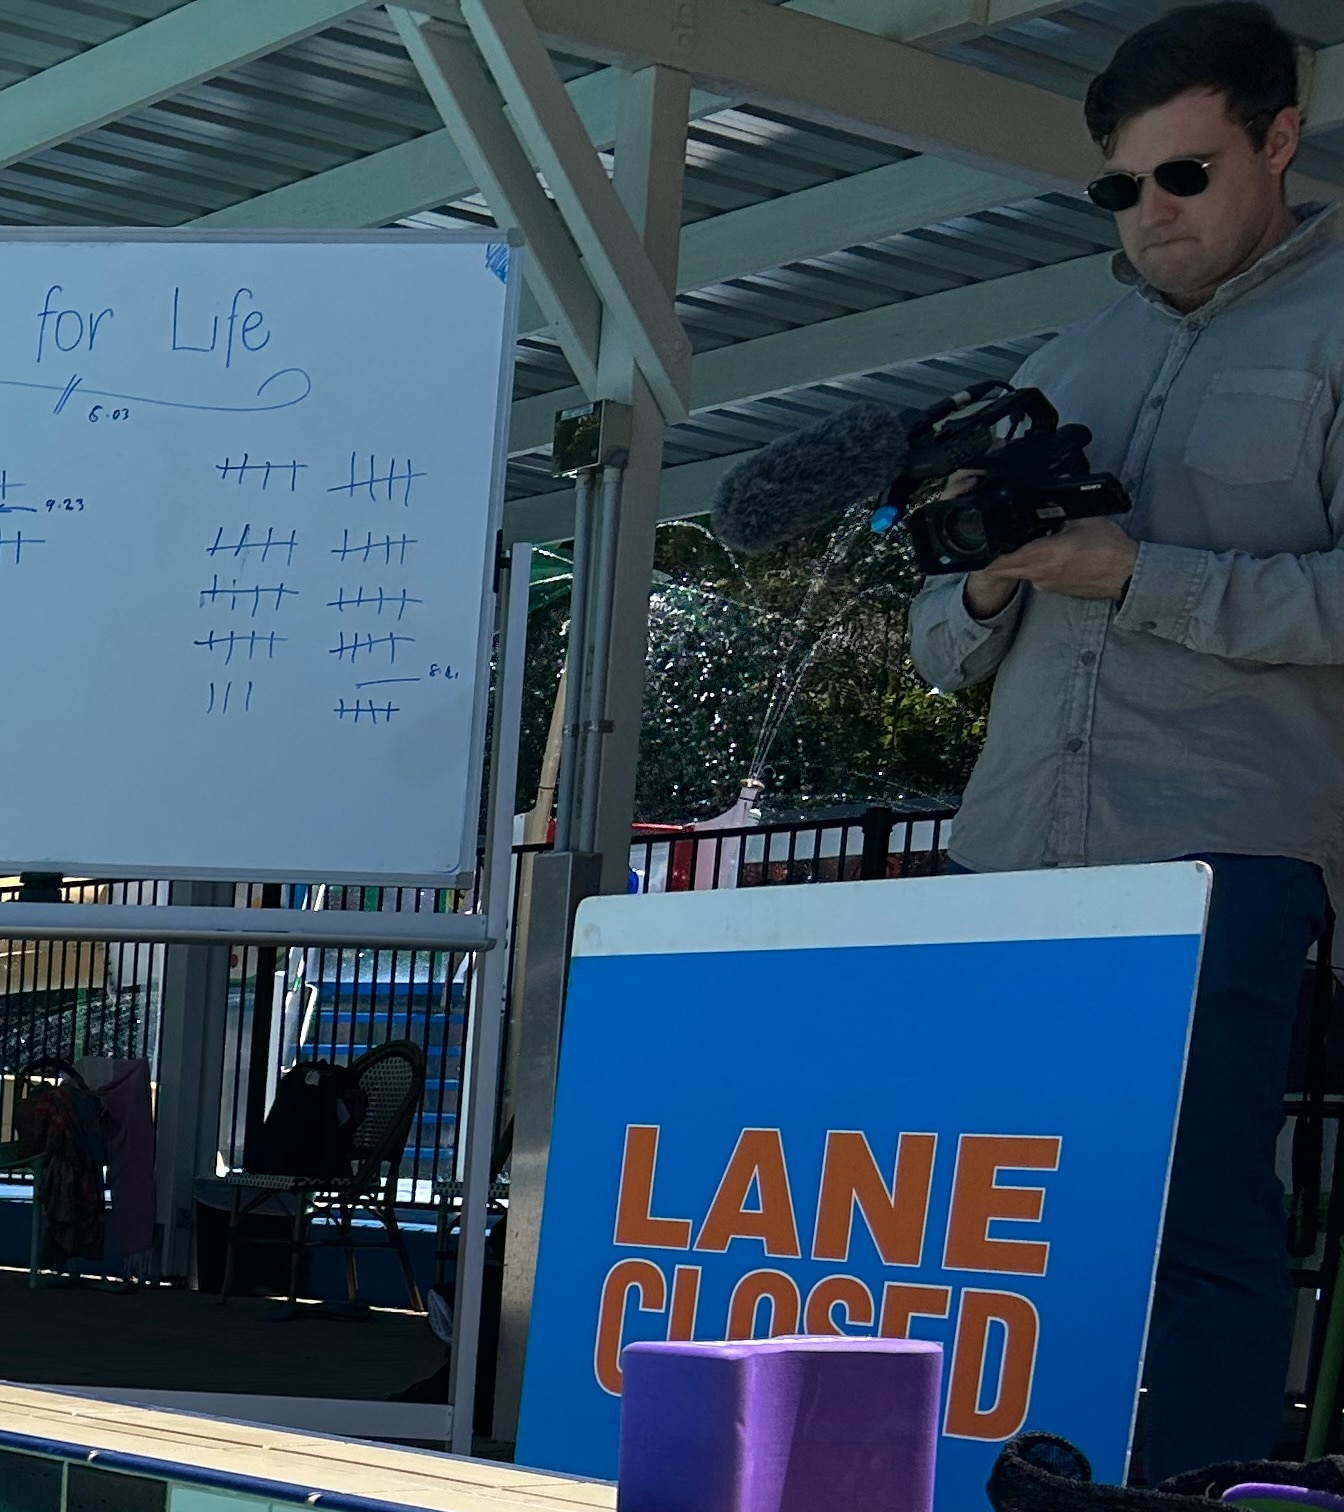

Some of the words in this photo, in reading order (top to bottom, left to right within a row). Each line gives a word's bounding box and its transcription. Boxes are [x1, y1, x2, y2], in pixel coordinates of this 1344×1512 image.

[37, 285, 114, 363] for
[171, 287, 272, 368] Life
[612, 1124, 1063, 1278] LANE
